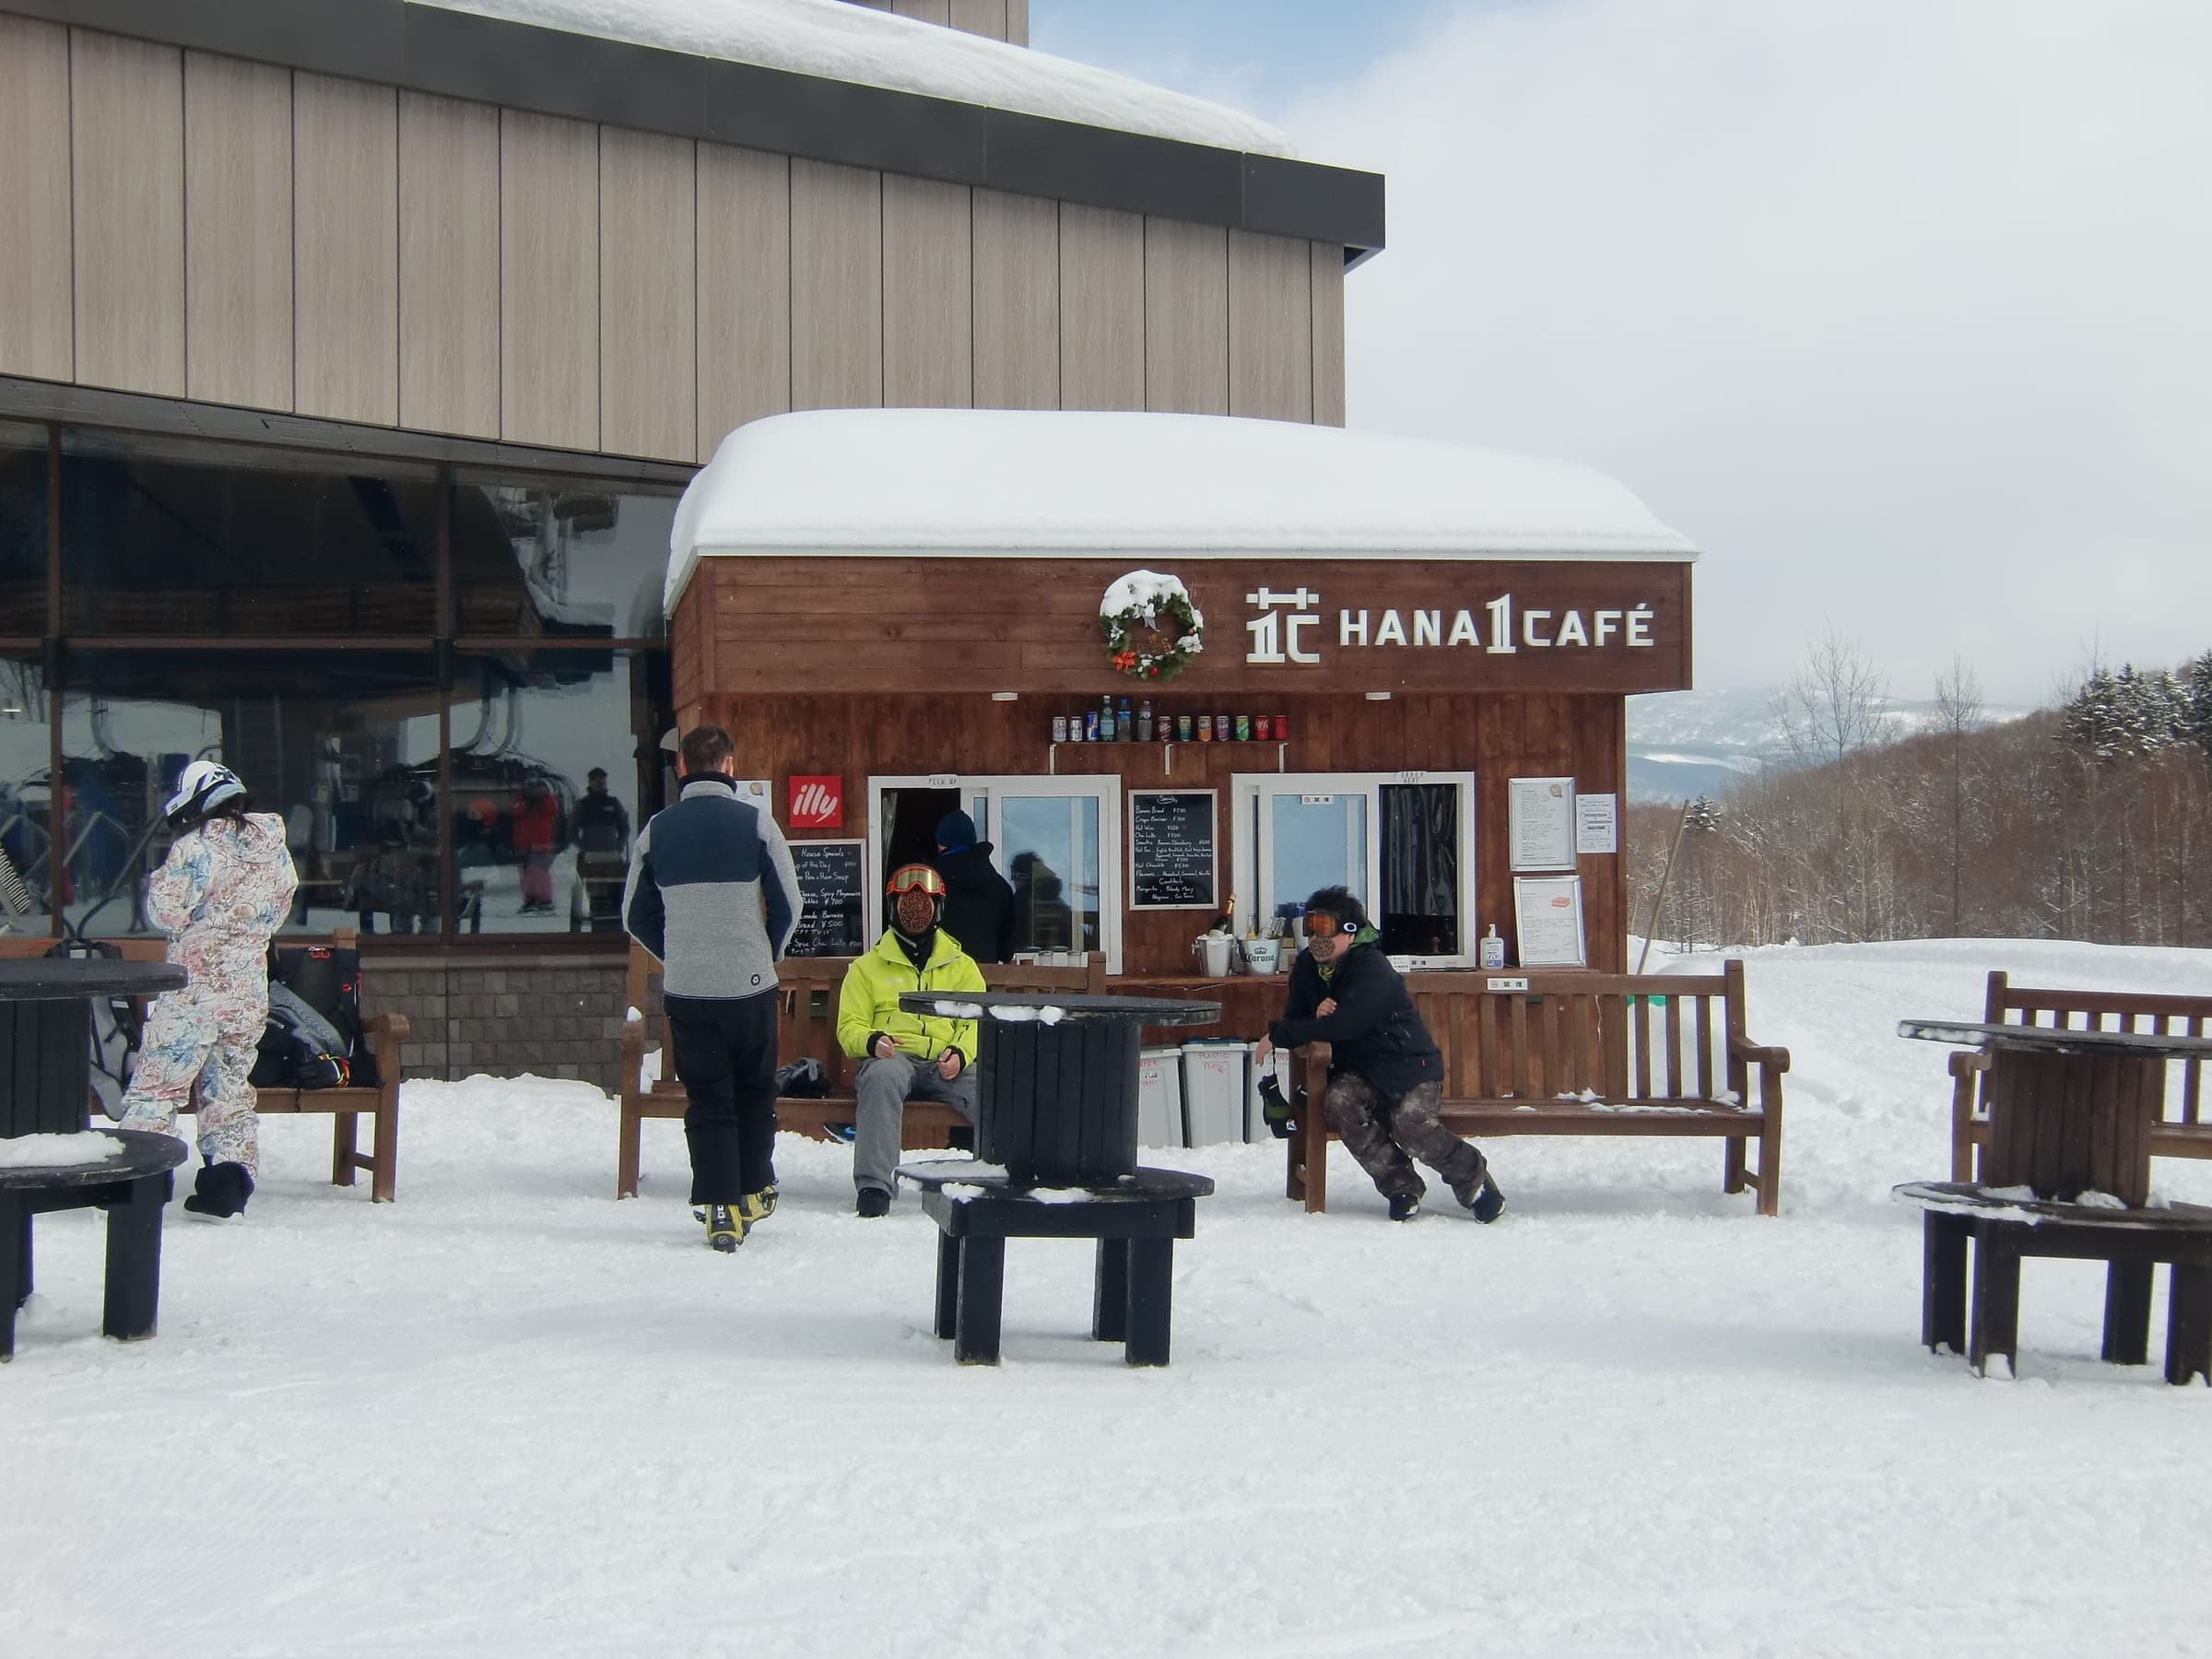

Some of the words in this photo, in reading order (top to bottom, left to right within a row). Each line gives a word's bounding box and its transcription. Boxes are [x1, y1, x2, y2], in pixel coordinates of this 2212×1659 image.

[793, 783, 838, 823] illy
[801, 848, 821, 857] House
[833, 871, 849, 883] Soup
[822, 910, 843, 918] Banana
[1246, 953, 1275, 964] Corona
[1199, 1052, 1230, 1060] PLASTIC
